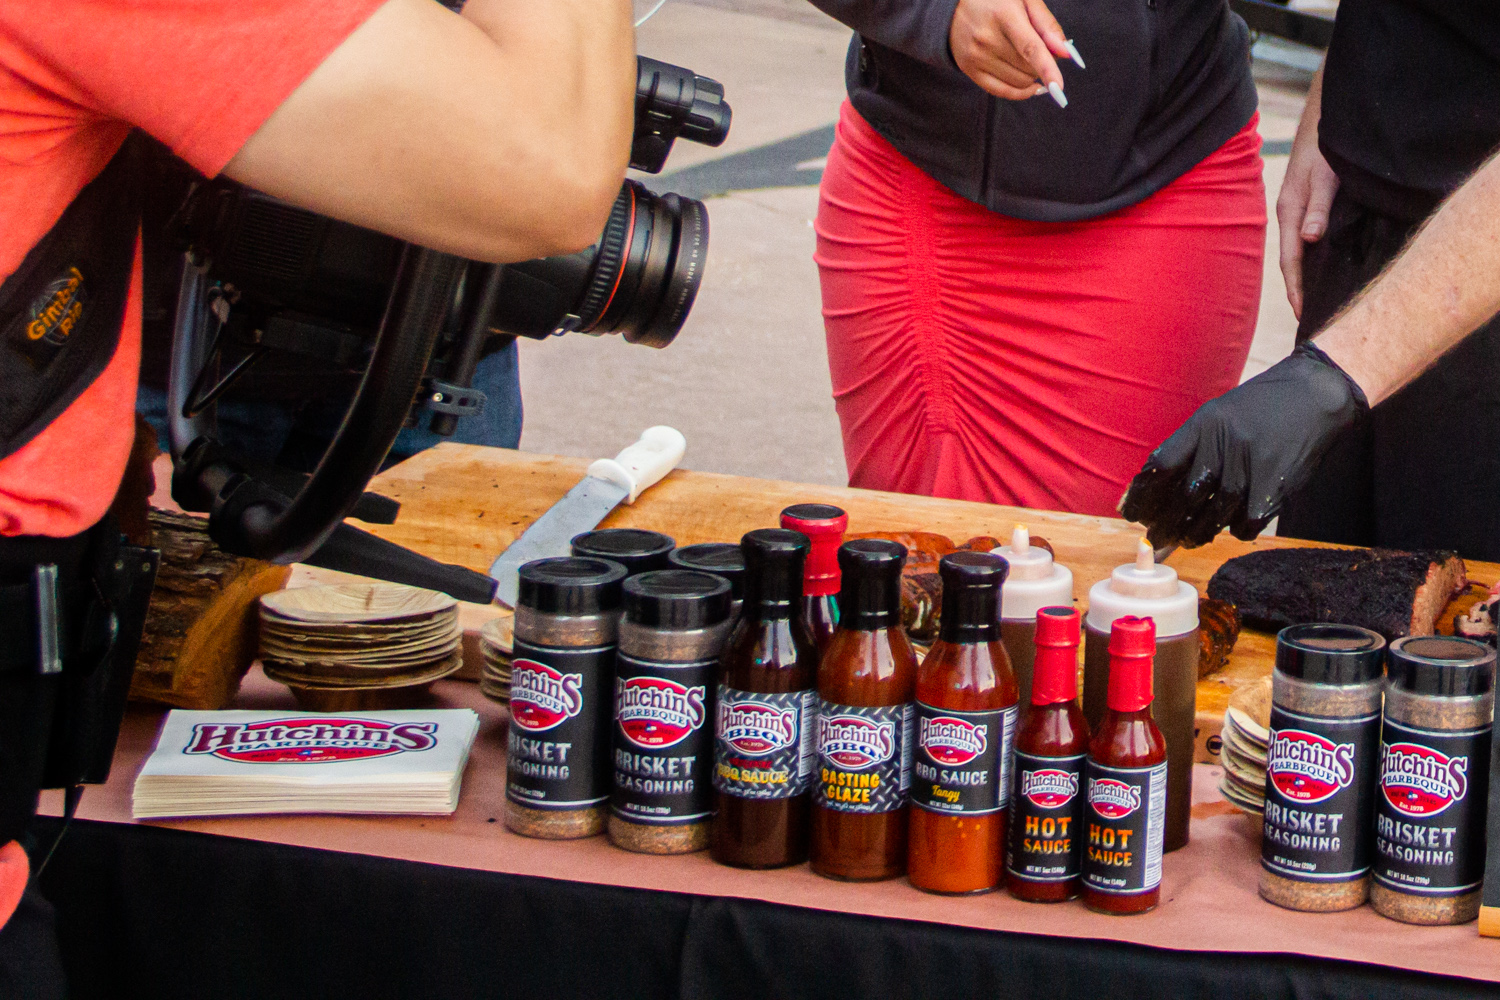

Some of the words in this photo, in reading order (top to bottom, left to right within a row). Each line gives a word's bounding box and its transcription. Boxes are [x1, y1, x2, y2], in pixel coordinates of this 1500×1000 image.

[624, 708, 686, 727] BARBEQUE
[236, 739, 387, 751] BARBEQUE
[729, 728, 783, 747] BBQ
[827, 742, 881, 760] BBQ
[615, 748, 696, 779] BRISKET
[717, 763, 740, 781] BBQ
[741, 769, 789, 785] SAUCE
[1274, 761, 1334, 783] BARBEQUE
[615, 772, 695, 795] SEASONING
[822, 768, 880, 788] BASTING
[940, 770, 988, 786] SAUCE
[1387, 775, 1447, 797] BARBEQUE
[827, 785, 871, 803] GLAZE
[932, 785, 961, 803] Tangy
[1026, 816, 1072, 838] HOT
[1265, 799, 1343, 834] BRISKET
[1090, 823, 1133, 849] HOT
[1264, 822, 1341, 852] SEASONING
[1378, 813, 1457, 848] BRISKET
[1023, 838, 1071, 855] SAUCE
[1088, 846, 1132, 867] SAUCE
[1377, 836, 1454, 866] SEASONING
